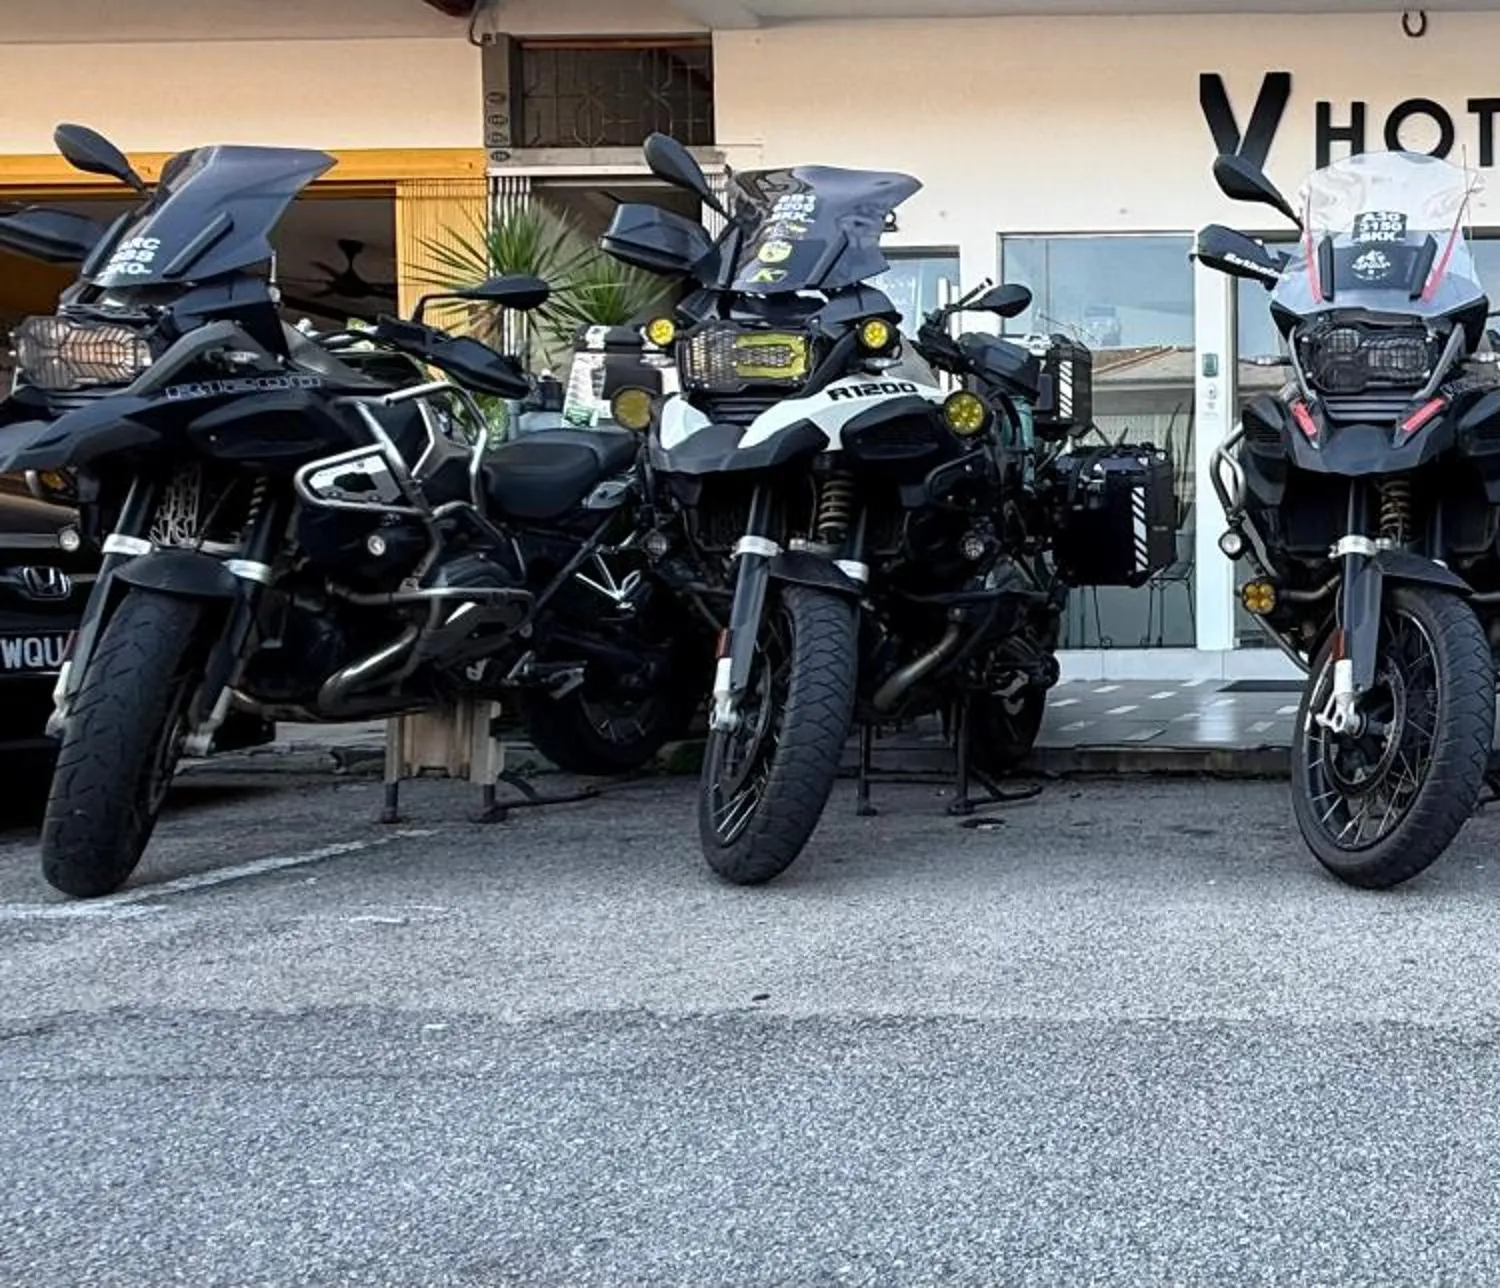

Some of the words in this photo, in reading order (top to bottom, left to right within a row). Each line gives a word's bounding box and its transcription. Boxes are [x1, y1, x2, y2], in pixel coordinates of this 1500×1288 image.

[1199, 72, 1292, 172] V
[827, 383, 919, 401] R1200
[0, 636, 63, 669] WQU
